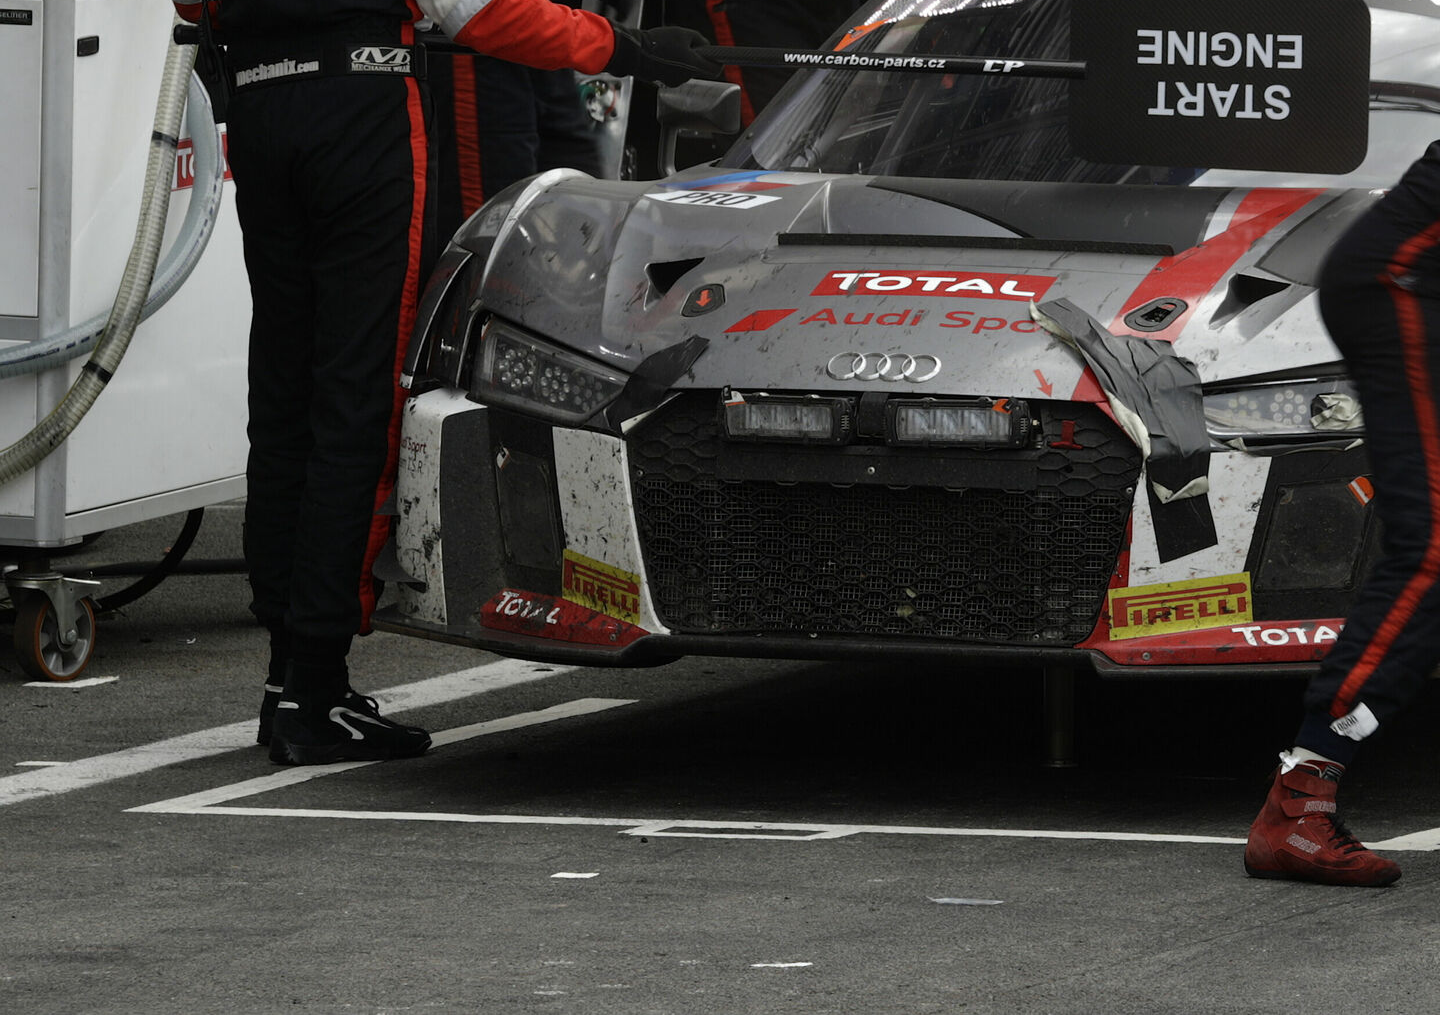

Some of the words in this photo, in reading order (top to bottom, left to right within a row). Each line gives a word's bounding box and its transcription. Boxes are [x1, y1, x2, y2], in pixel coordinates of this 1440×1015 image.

[782, 52, 947, 70] www.carbon-parts.cz
[1136, 29, 1303, 69] ENGINE
[236, 58, 320, 87] mechanix.com
[1147, 81, 1291, 120] START
[670, 191, 759, 206] PRO
[831, 272, 1036, 298] TOTAL
[800, 307, 927, 328] Audi
[938, 310, 1048, 336] Spo
[564, 558, 640, 615] PIRELLI
[1112, 582, 1247, 628] PIRELLI
[1231, 625, 1346, 647] TOTA
